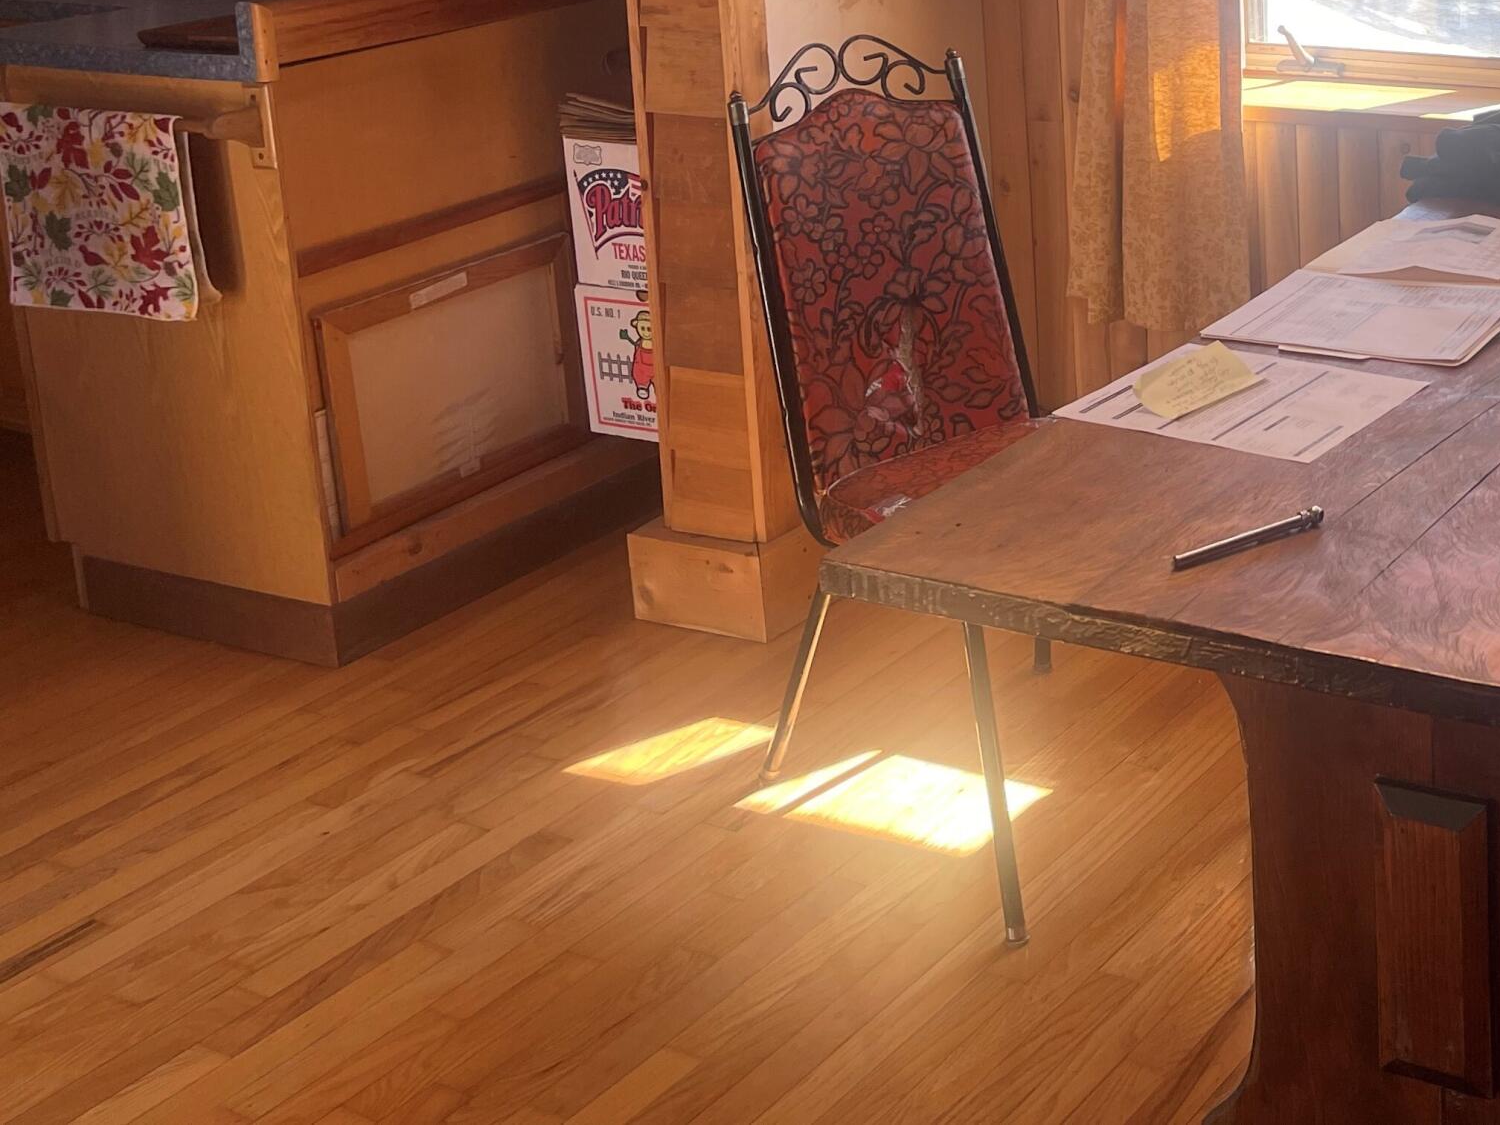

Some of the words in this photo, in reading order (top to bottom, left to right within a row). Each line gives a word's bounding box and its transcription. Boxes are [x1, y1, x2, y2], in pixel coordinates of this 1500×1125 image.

[612, 242, 646, 263] TEXAS
[590, 305, 603, 317] U.S.
[621, 396, 642, 411] The
